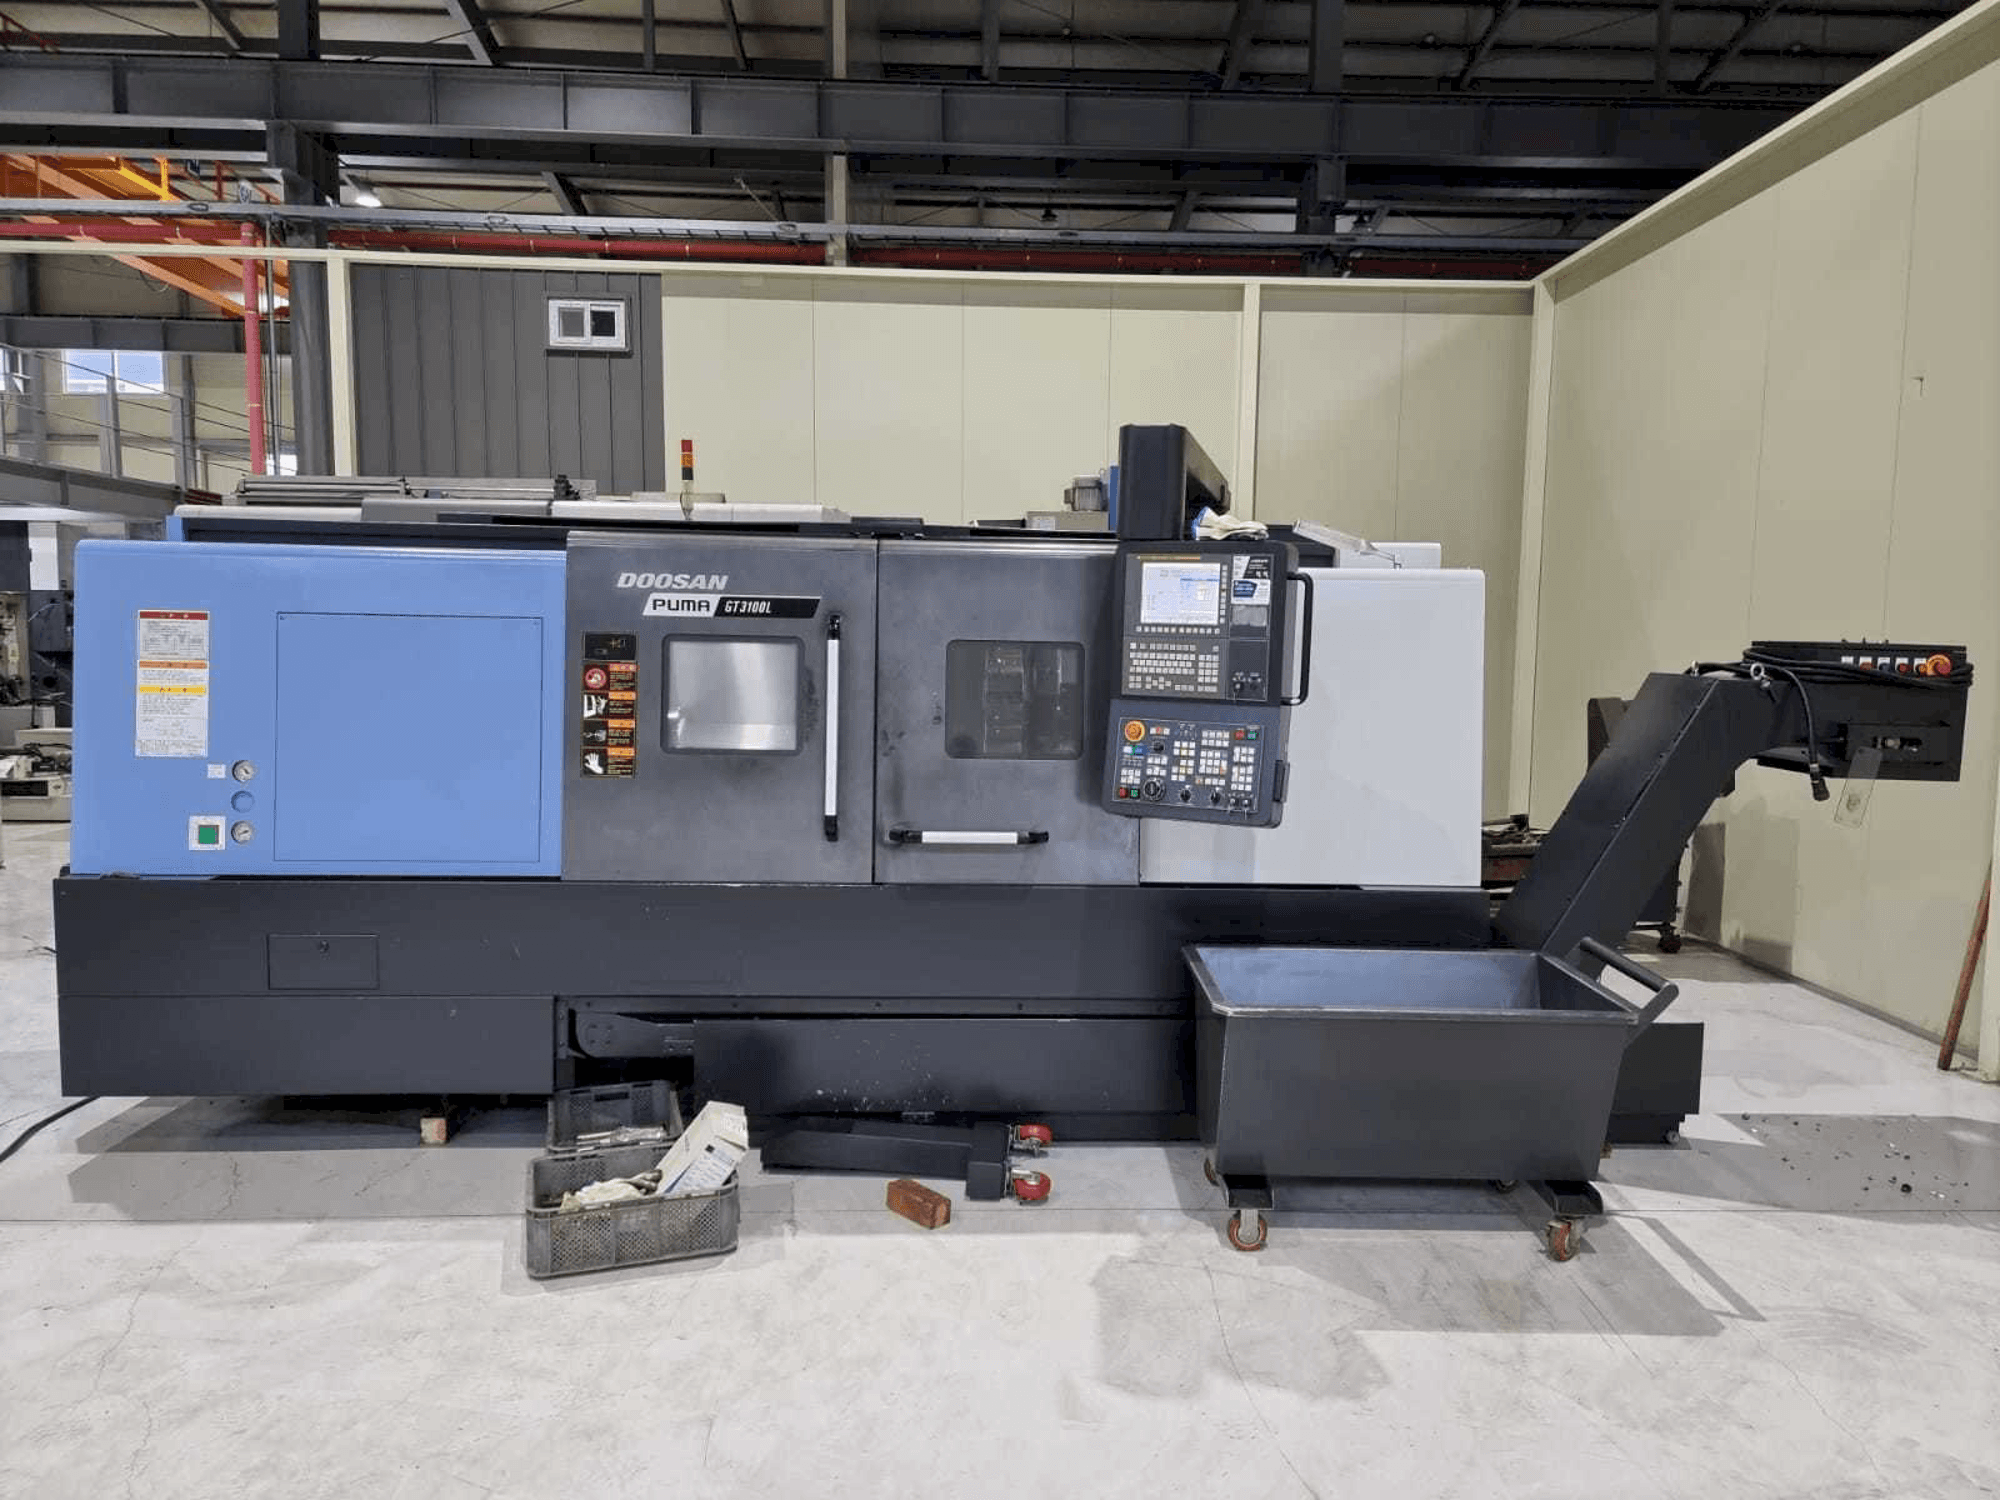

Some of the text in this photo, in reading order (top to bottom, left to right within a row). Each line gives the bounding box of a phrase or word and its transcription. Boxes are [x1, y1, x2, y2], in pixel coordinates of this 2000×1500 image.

[617, 572, 729, 590] DOOSAN
[652, 599, 771, 613] PUMA GT3100L
